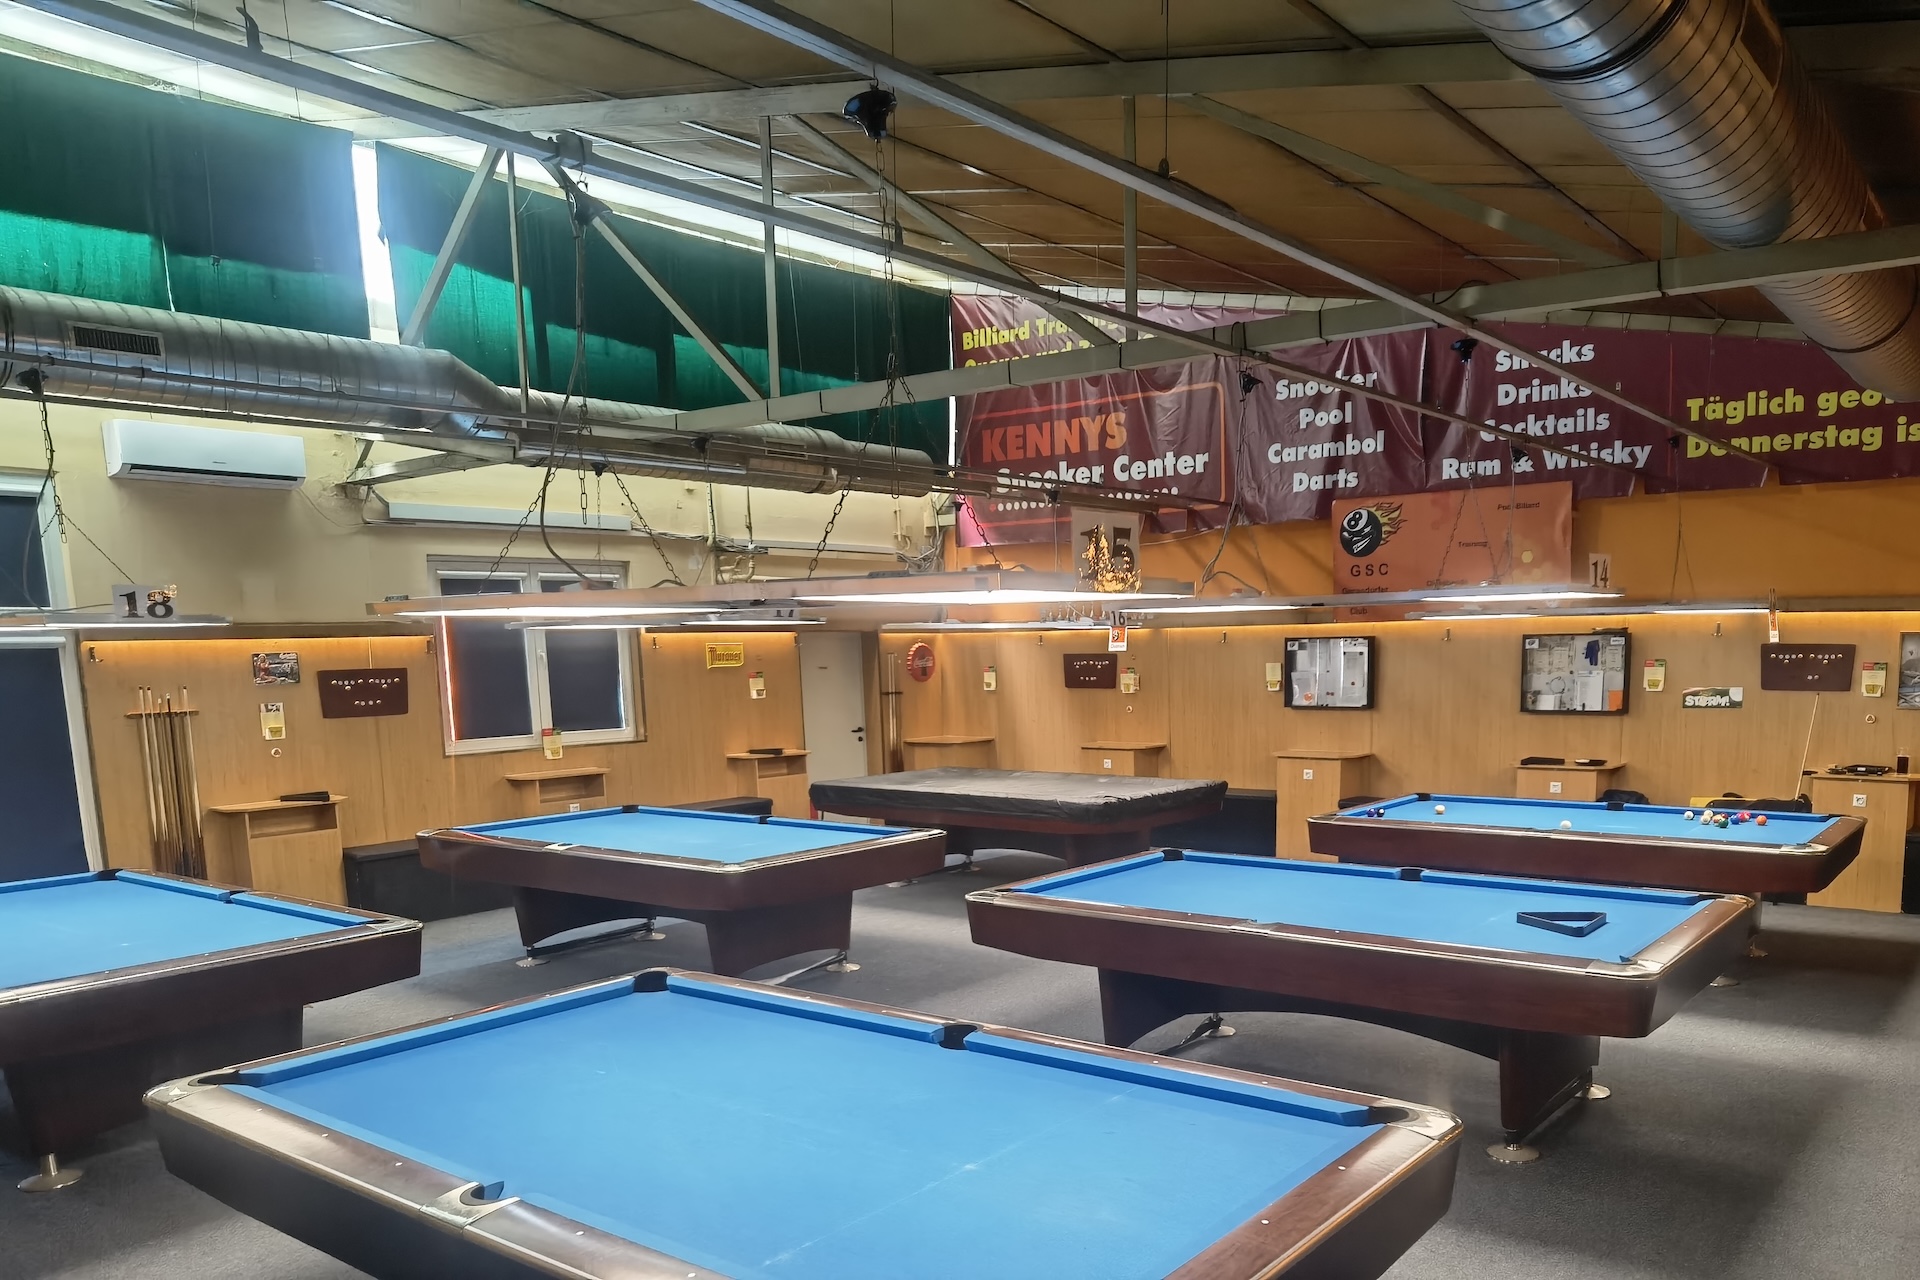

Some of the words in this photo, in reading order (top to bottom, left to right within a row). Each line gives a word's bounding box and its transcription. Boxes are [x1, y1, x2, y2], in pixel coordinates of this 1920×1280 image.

[963, 320, 1030, 350] Billiard
[1498, 377, 1593, 406] Drinks
[1686, 388, 1804, 424] Täglich
[1299, 401, 1352, 429] Pool
[1480, 407, 1610, 442] Cocktails
[982, 411, 1127, 463] KENNYS
[1267, 430, 1385, 464] Carambol
[1686, 425, 1882, 458] Donnerstag
[1113, 451, 1209, 481] Center
[1441, 457, 1501, 481] Rum
[1543, 440, 1653, 471] Whisky
[1292, 467, 1359, 493] Darts
[1080, 525, 1135, 580] 15
[1591, 558, 1609, 588] 14
[119, 590, 173, 618] 18
[1111, 610, 1126, 626] 16
